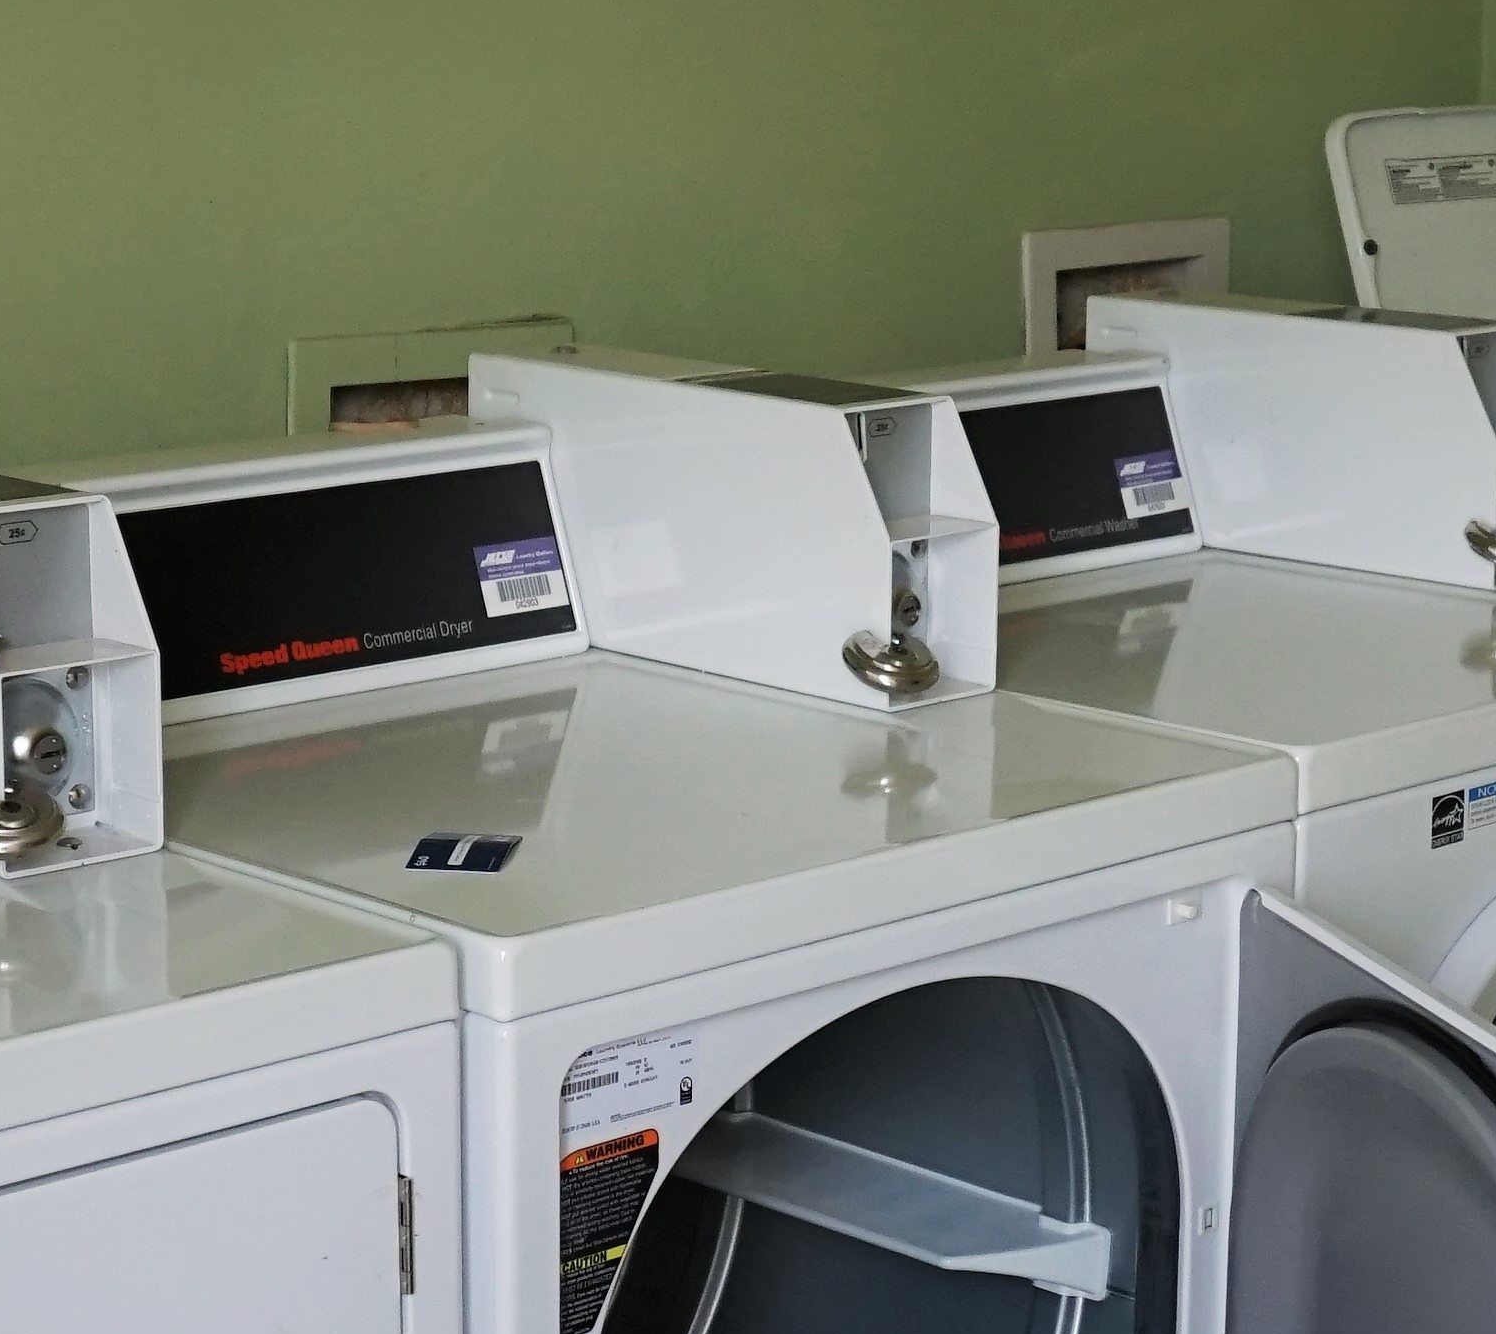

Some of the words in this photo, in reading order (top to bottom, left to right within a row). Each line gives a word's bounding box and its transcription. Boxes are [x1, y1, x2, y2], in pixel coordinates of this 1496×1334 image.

[1049, 521, 1104, 542] Commercial
[219, 643, 289, 675] Speed
[291, 636, 360, 661] Queen
[363, 623, 437, 650] Commercial
[440, 619, 473, 639] Dryer
[585, 1134, 644, 1161] WARNING
[562, 1250, 607, 1274] CAUTION
